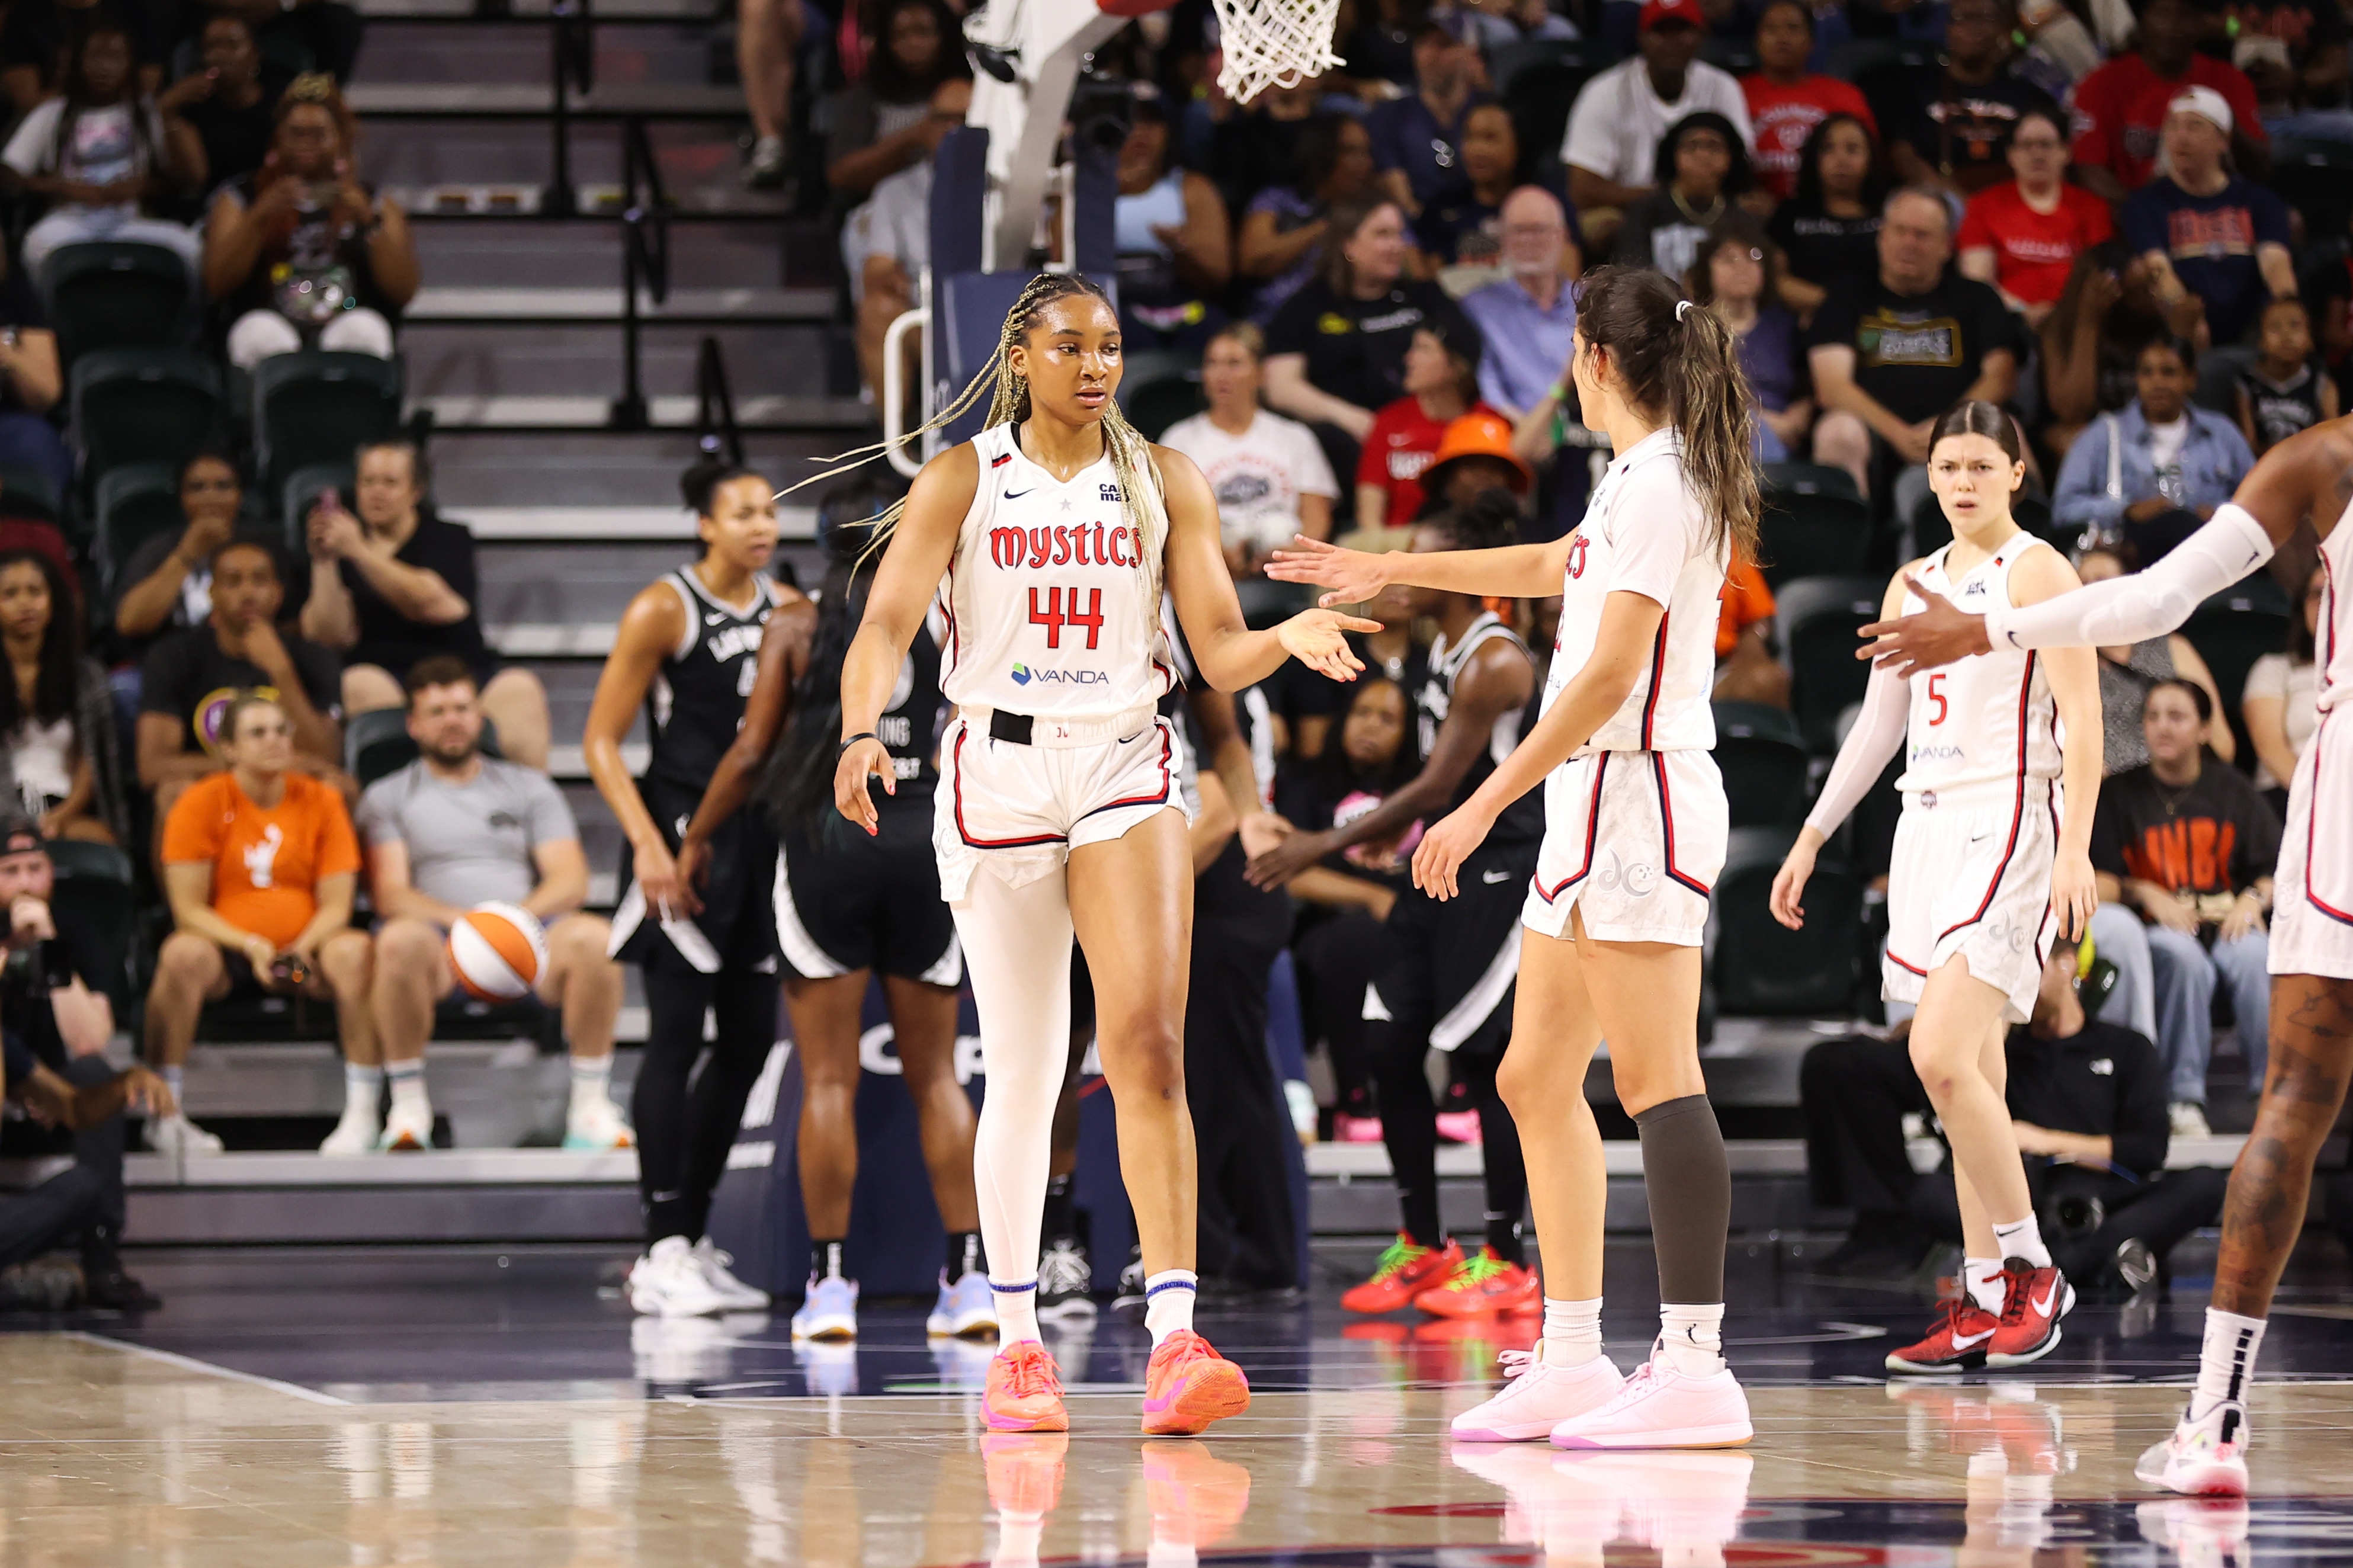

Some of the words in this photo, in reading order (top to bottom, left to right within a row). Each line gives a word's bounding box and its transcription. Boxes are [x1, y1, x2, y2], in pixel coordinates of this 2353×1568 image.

[1028, 586, 1104, 650] 44
[1033, 668, 1110, 685] VANDA
[1929, 674, 1948, 726] 5
